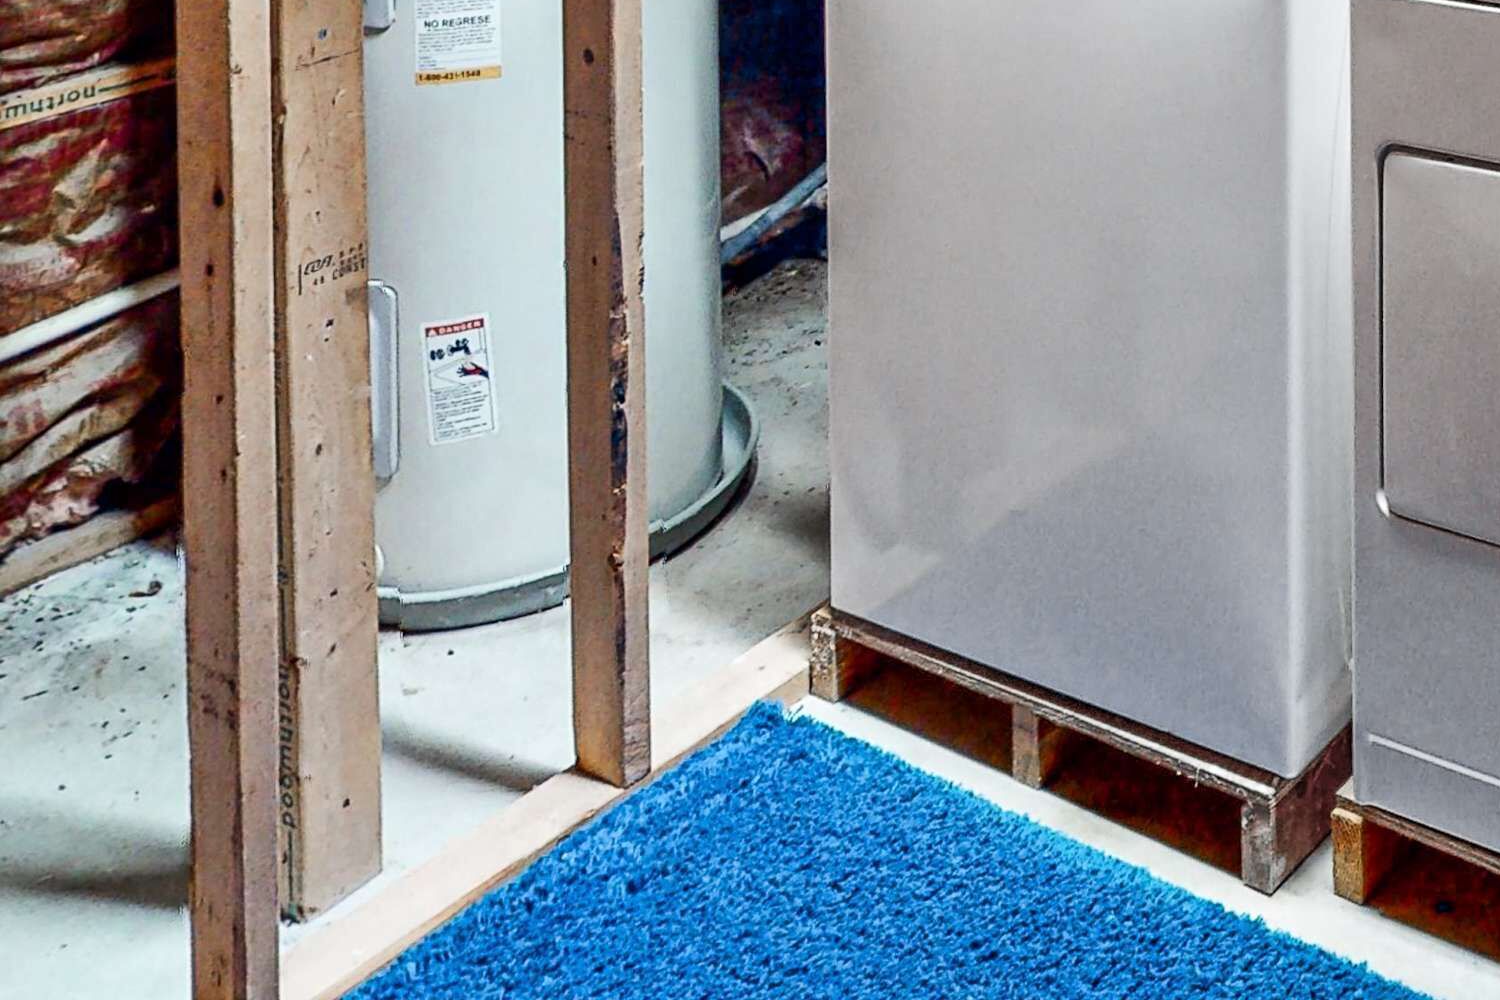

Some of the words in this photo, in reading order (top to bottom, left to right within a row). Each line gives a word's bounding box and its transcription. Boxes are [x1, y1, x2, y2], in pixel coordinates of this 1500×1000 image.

[424, 19, 439, 29] NO
[441, 15, 492, 27] REGRESE
[0, 85, 96, 119] northw
[438, 320, 482, 335] DANGER
[278, 663, 296, 829] northwood
